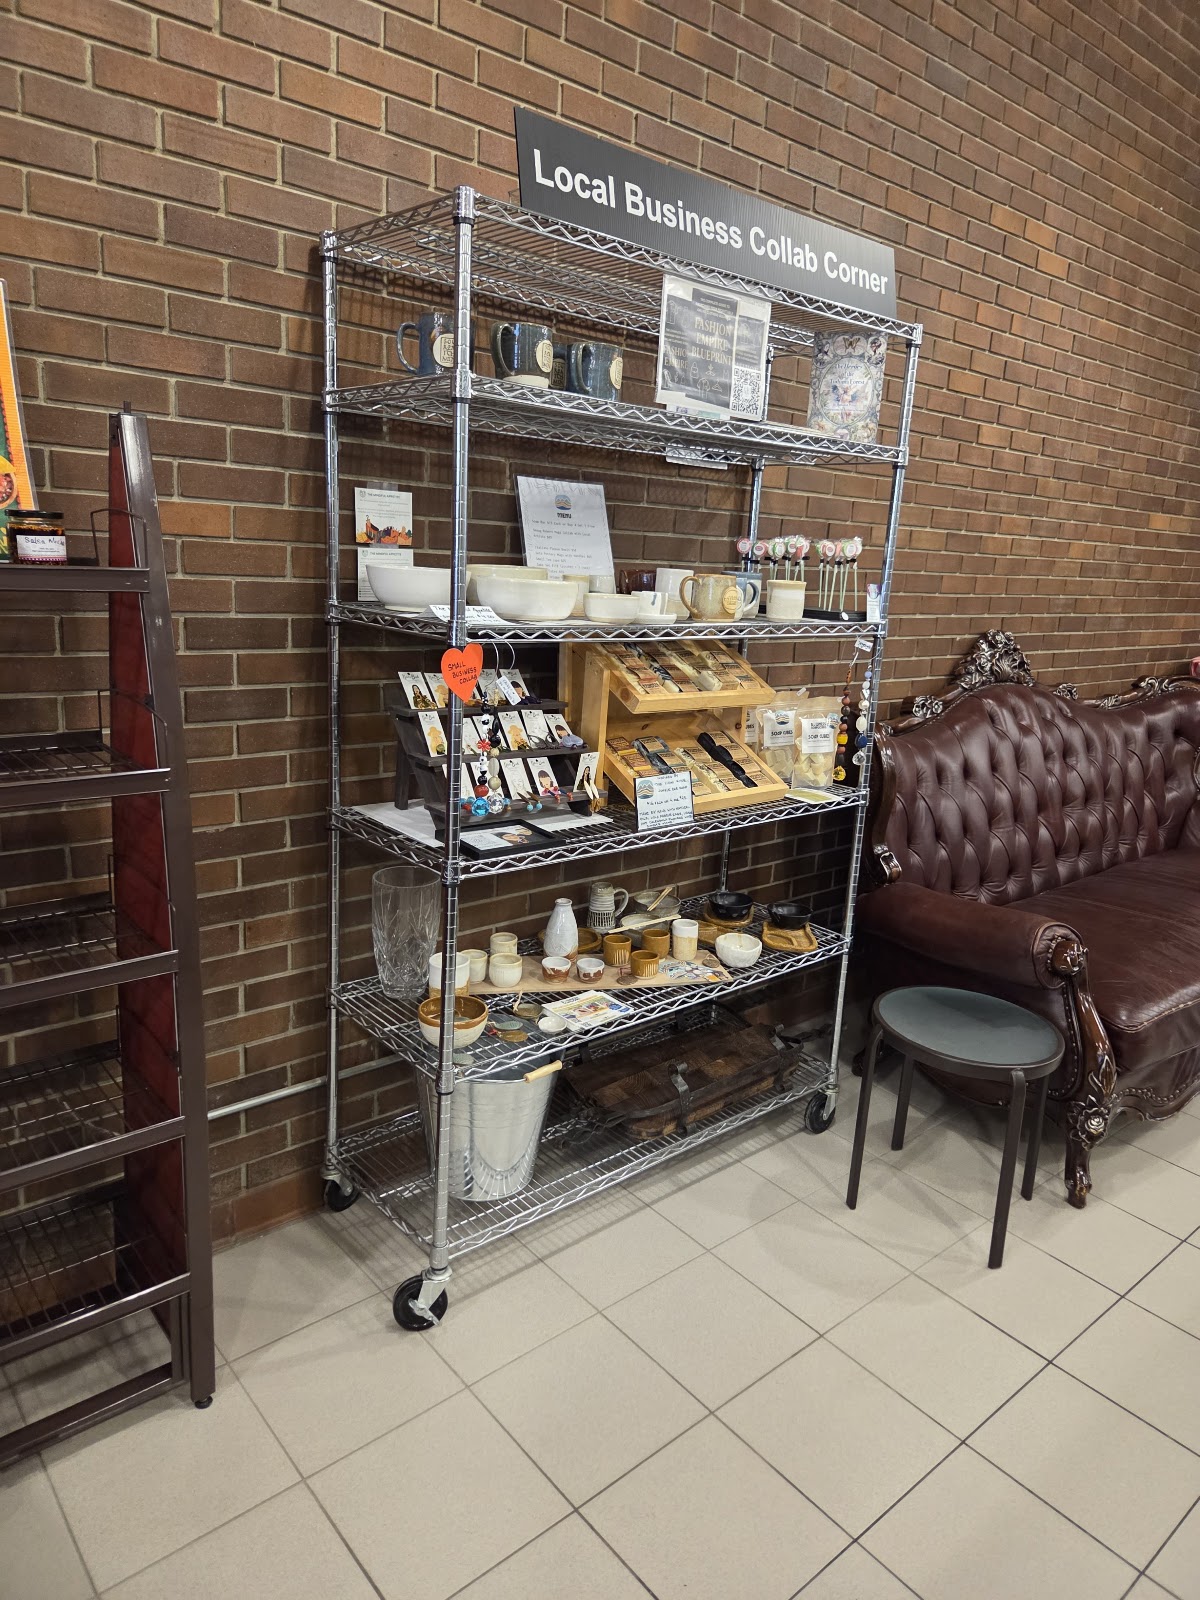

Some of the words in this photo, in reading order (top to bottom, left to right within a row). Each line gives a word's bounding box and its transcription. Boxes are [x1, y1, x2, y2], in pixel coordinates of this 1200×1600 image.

[533, 148, 616, 209] Local
[624, 181, 743, 249] Business
[750, 226, 818, 273] Collab
[823, 251, 888, 295] Corner
[694, 316, 734, 337] FASHION
[696, 332, 729, 352] EMPIRE
[691, 346, 732, 366] BLUEPRINT
[24, 536, 46, 545] Salsa
[448, 661, 466, 672] SMALL
[452, 666, 477, 679] BUSINESS
[459, 674, 478, 685] COLLAB
